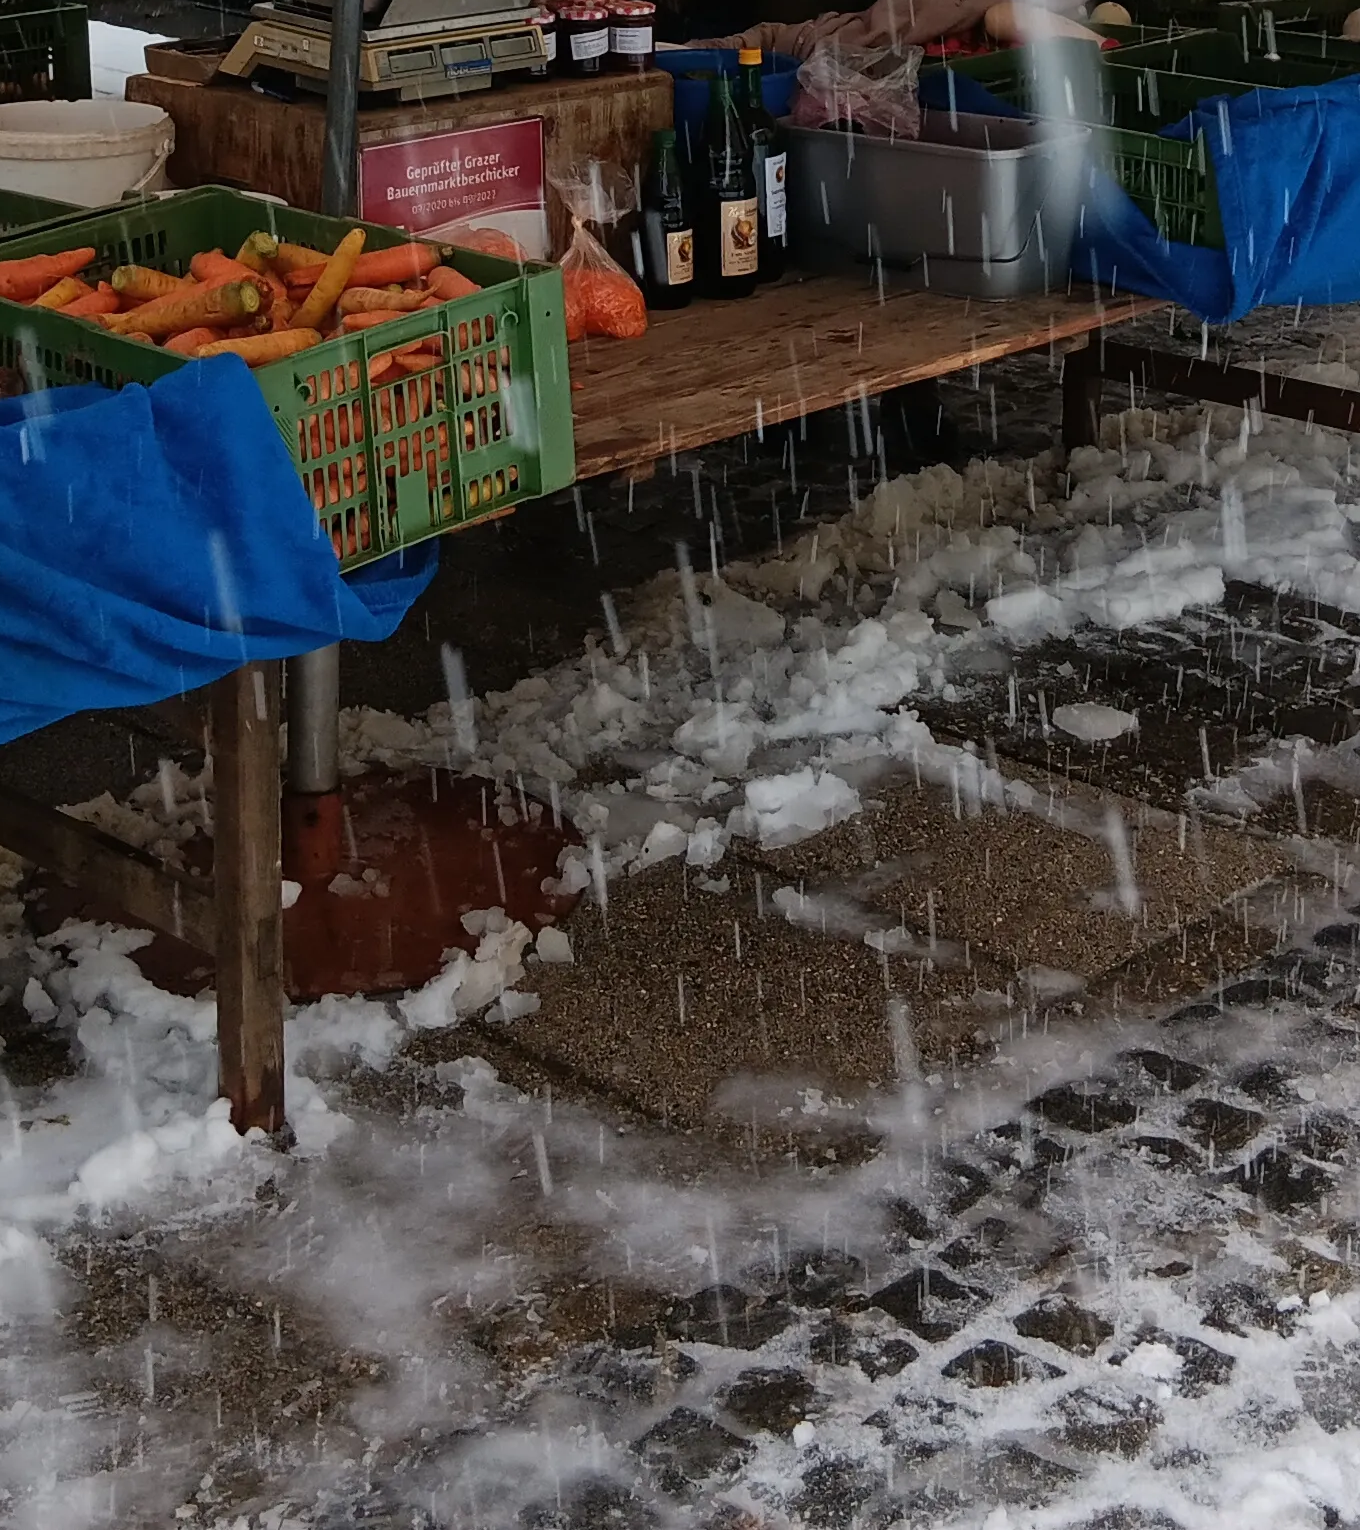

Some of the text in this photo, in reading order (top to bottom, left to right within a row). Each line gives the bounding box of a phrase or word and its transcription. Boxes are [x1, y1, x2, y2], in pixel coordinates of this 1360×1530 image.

[406, 153, 501, 180] Geprüfter Grazer
[386, 165, 521, 201] Bauernmarktbeschicker
[448, 196, 461, 208] bis
